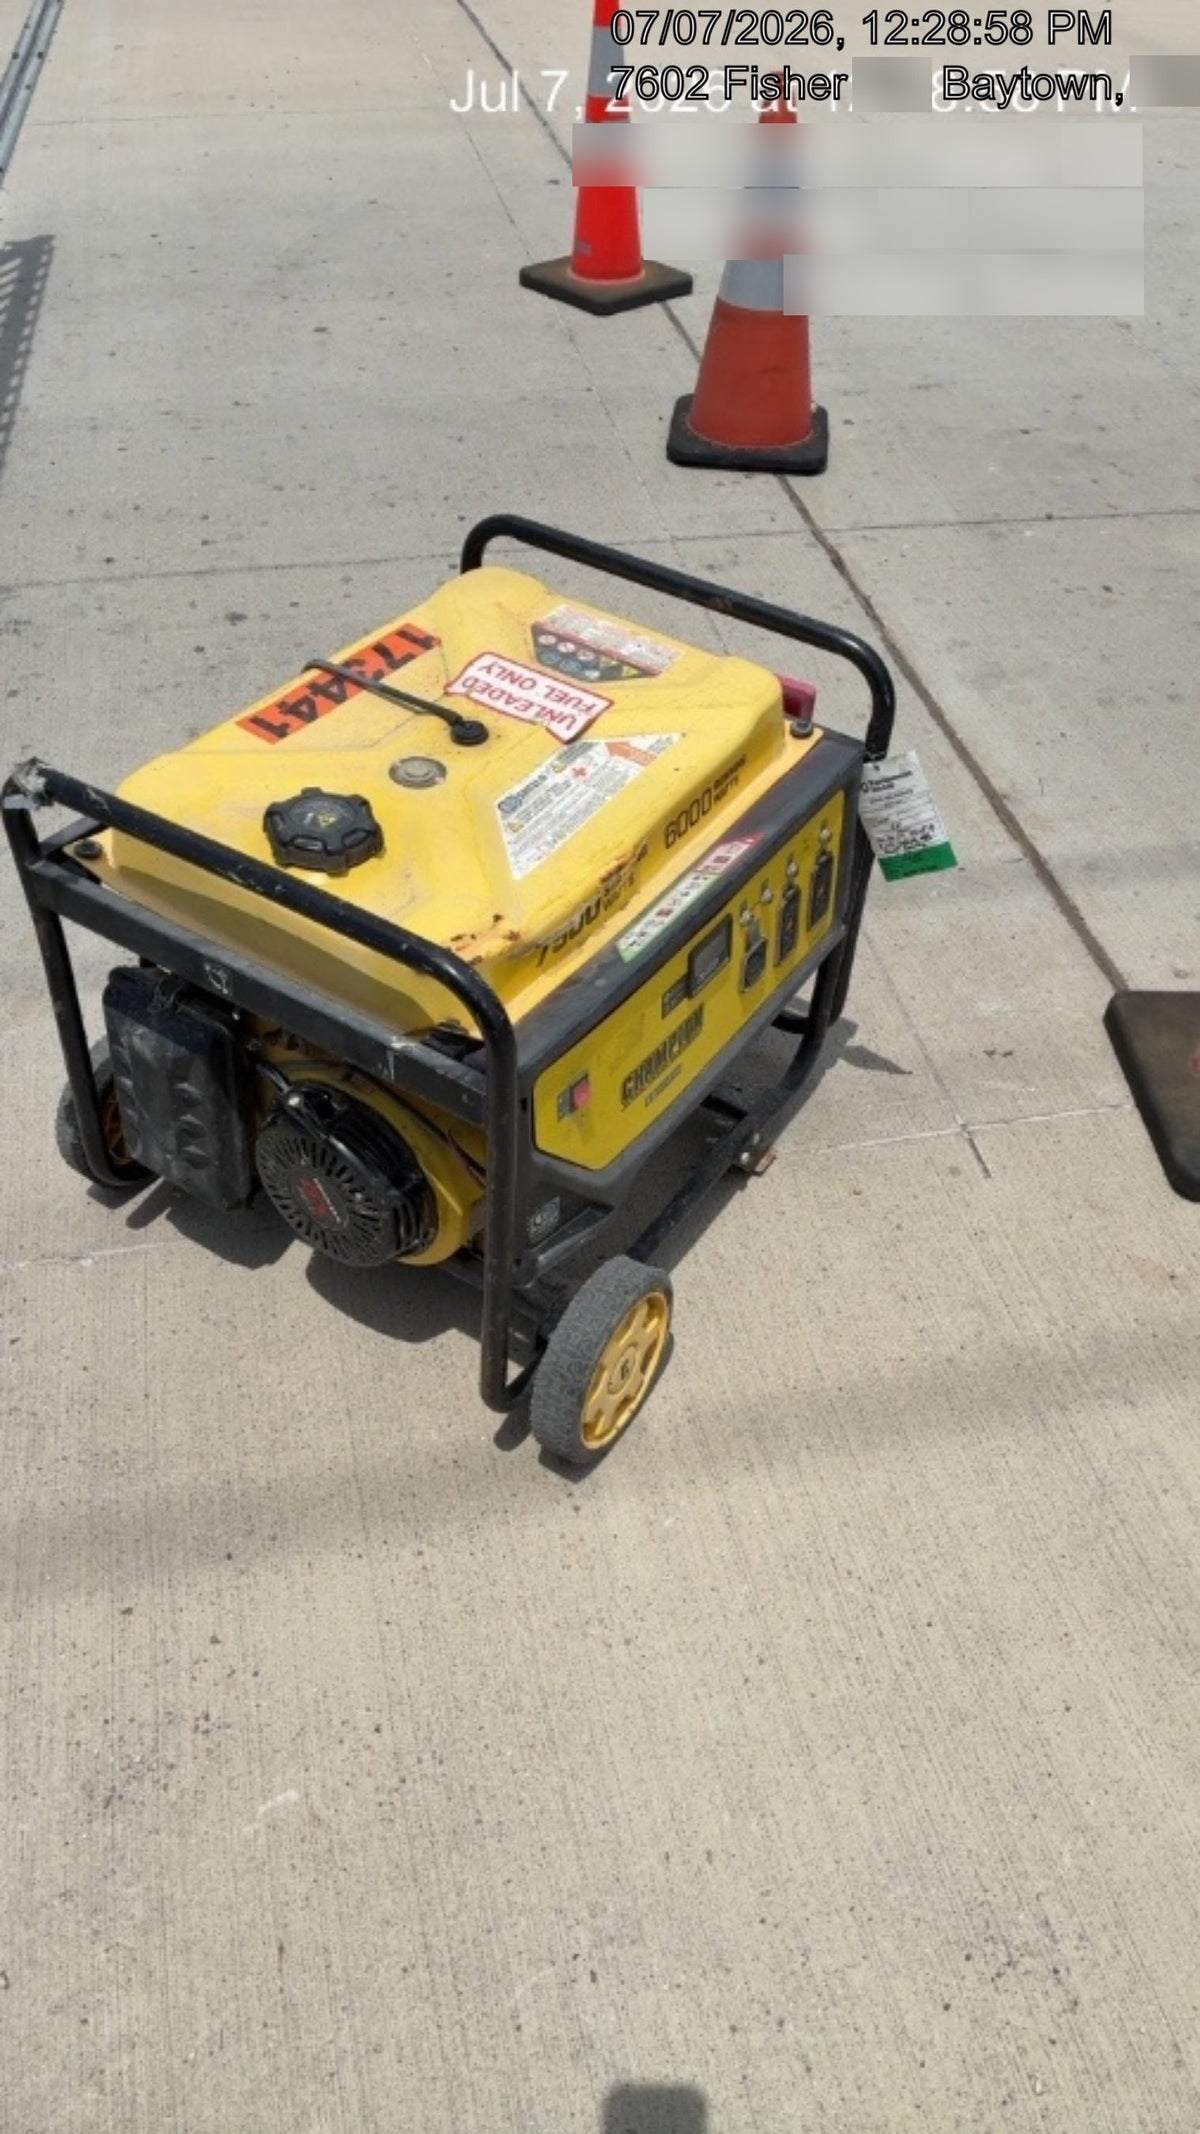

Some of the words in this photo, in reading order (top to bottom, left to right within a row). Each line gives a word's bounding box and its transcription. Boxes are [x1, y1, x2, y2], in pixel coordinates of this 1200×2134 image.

[478, 661, 537, 690] ONLY
[461, 676, 577, 731] UNLEADED
[543, 685, 597, 713] FUEL
[665, 788, 713, 849] 6000
